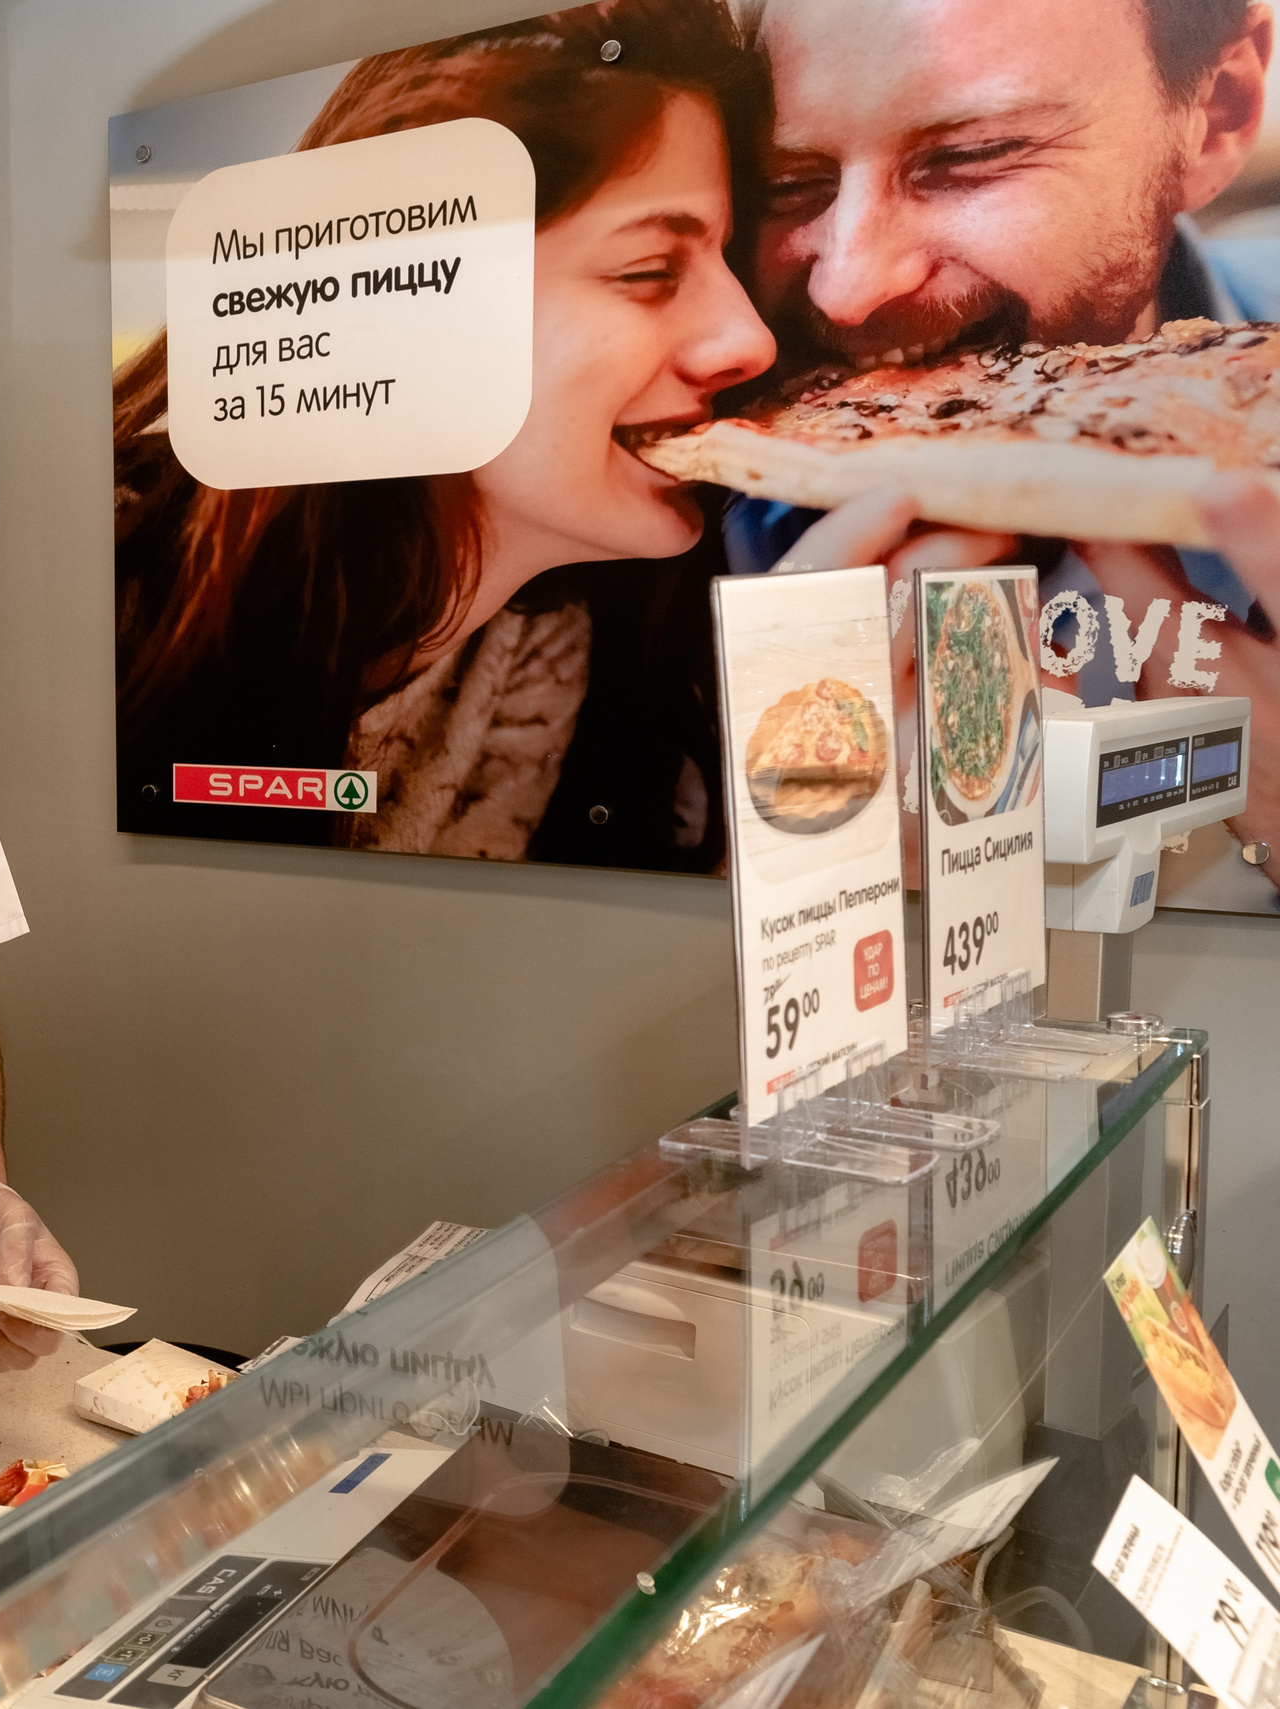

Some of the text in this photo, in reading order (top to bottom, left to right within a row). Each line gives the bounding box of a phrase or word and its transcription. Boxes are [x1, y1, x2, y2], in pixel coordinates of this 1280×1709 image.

[212, 195, 478, 264] Мы приготовим
[212, 257, 462, 316] свежую пиццу
[212, 331, 331, 377] для вас
[213, 378, 397, 422] за 15 минут
[1039, 589, 1228, 694] OVE
[208, 773, 323, 801] SPAR
[941, 831, 1034, 877] Пицца Сицилия
[760, 876, 901, 943] Кусок пиццы Пепперони
[762, 955, 774, 973] по
[776, 937, 814, 972] рецепту
[863, 942, 883, 962] УДАР
[867, 963, 880, 978] ПО
[859, 976, 889, 1000] ЦЕНАМ!
[197, 1568, 237, 1595] CAS
